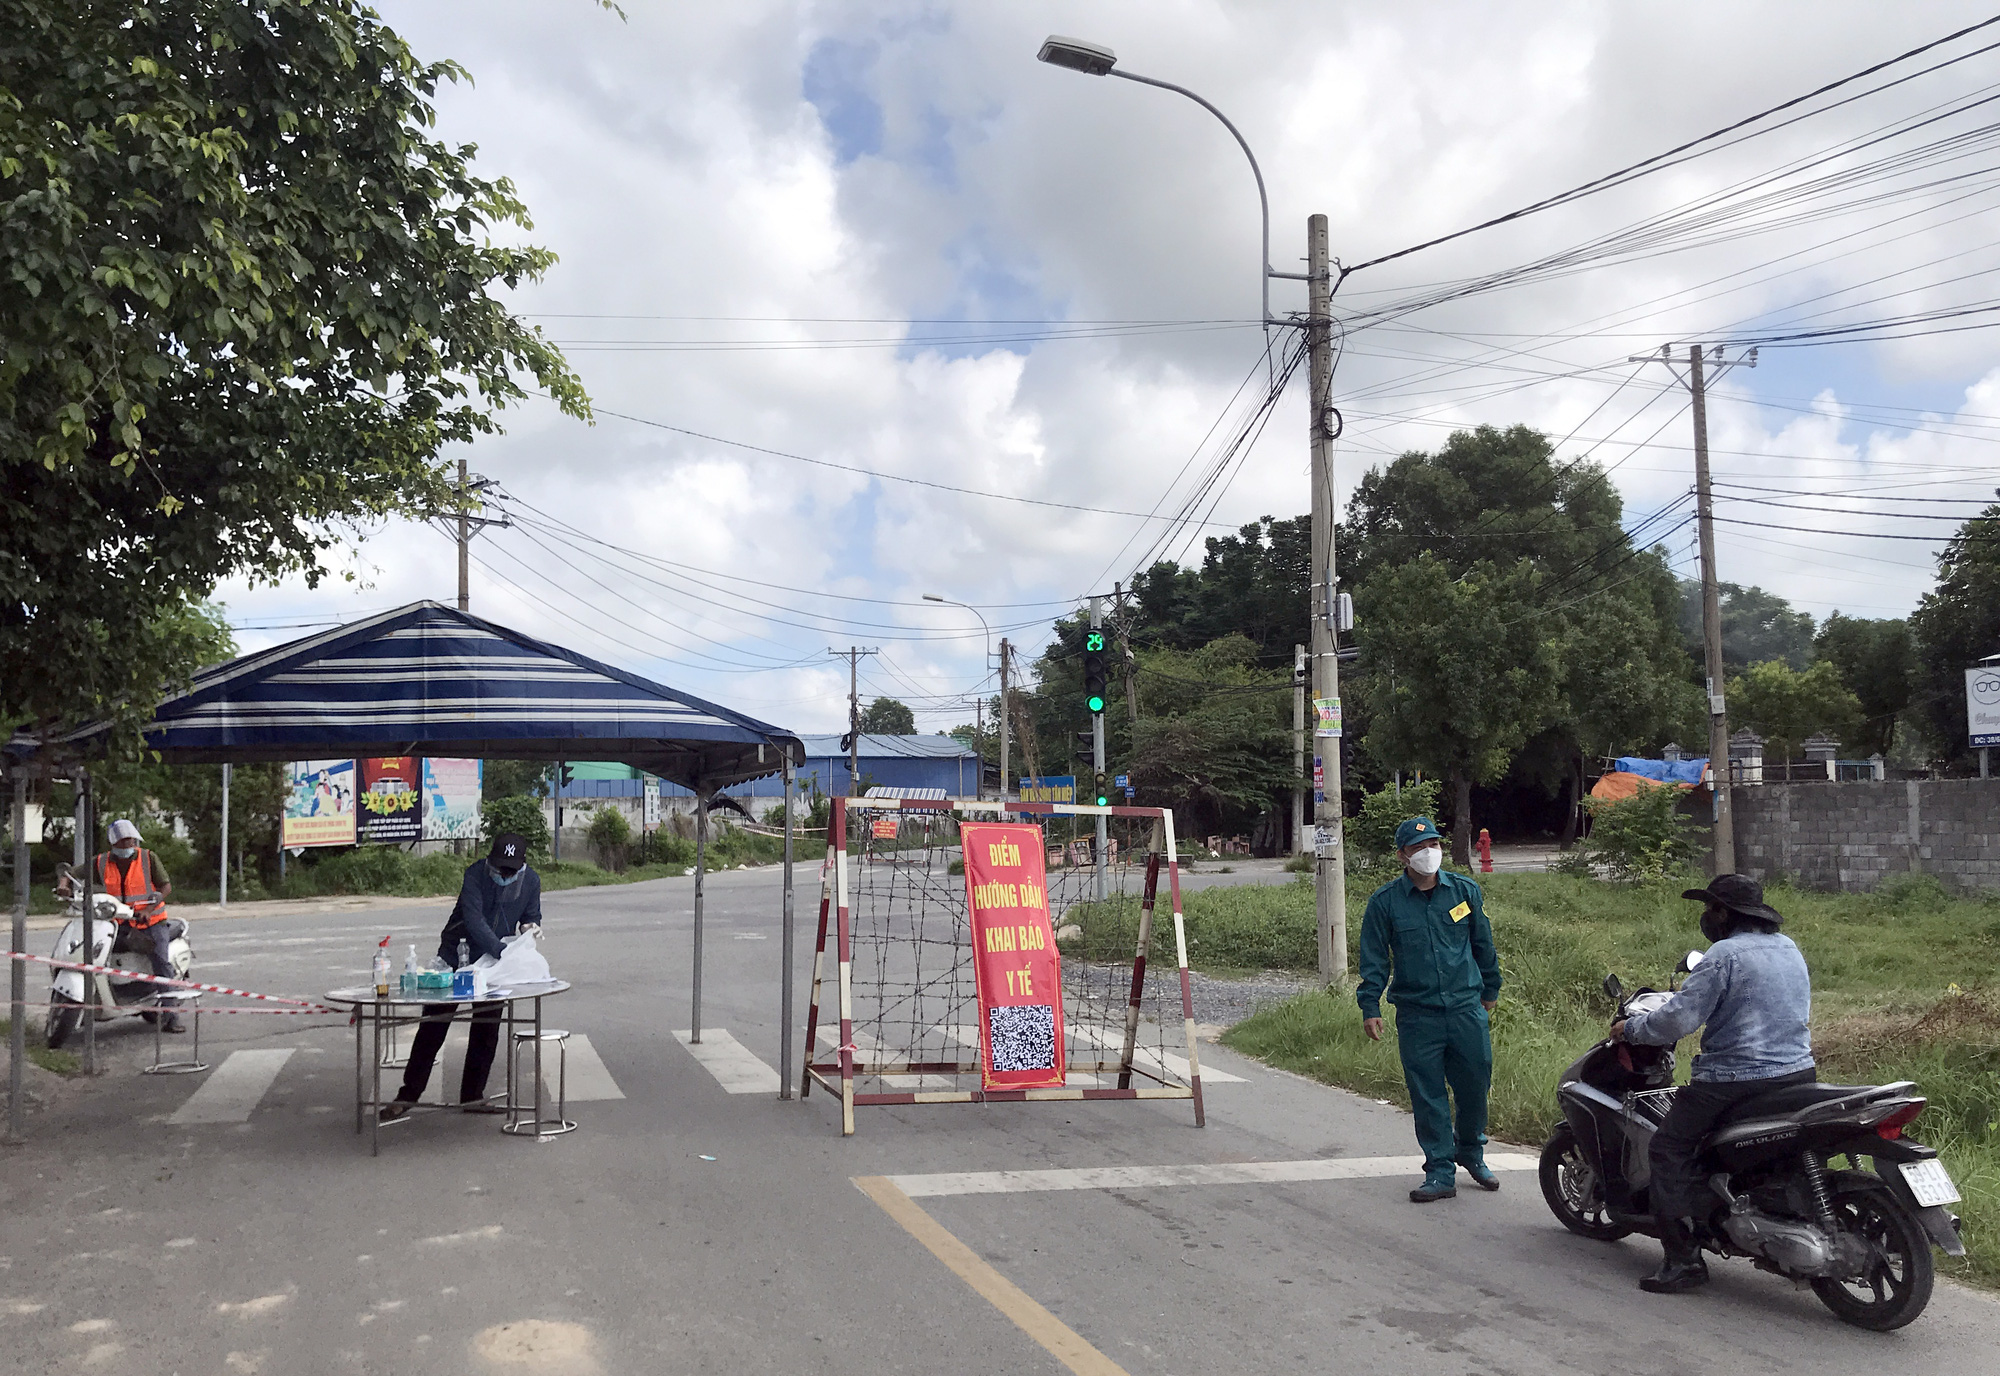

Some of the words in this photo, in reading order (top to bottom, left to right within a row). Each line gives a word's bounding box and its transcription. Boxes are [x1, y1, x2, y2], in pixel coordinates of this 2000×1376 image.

[989, 835, 1022, 867] ĐIỂM
[974, 880, 1017, 910] HƯỚNG
[1019, 875, 1043, 910] DẪN
[985, 927, 1017, 953] KHAI
[1018, 920, 1045, 952] BÁO
[1005, 970, 1015, 997] Y
[1017, 961, 1034, 997] TẾ
